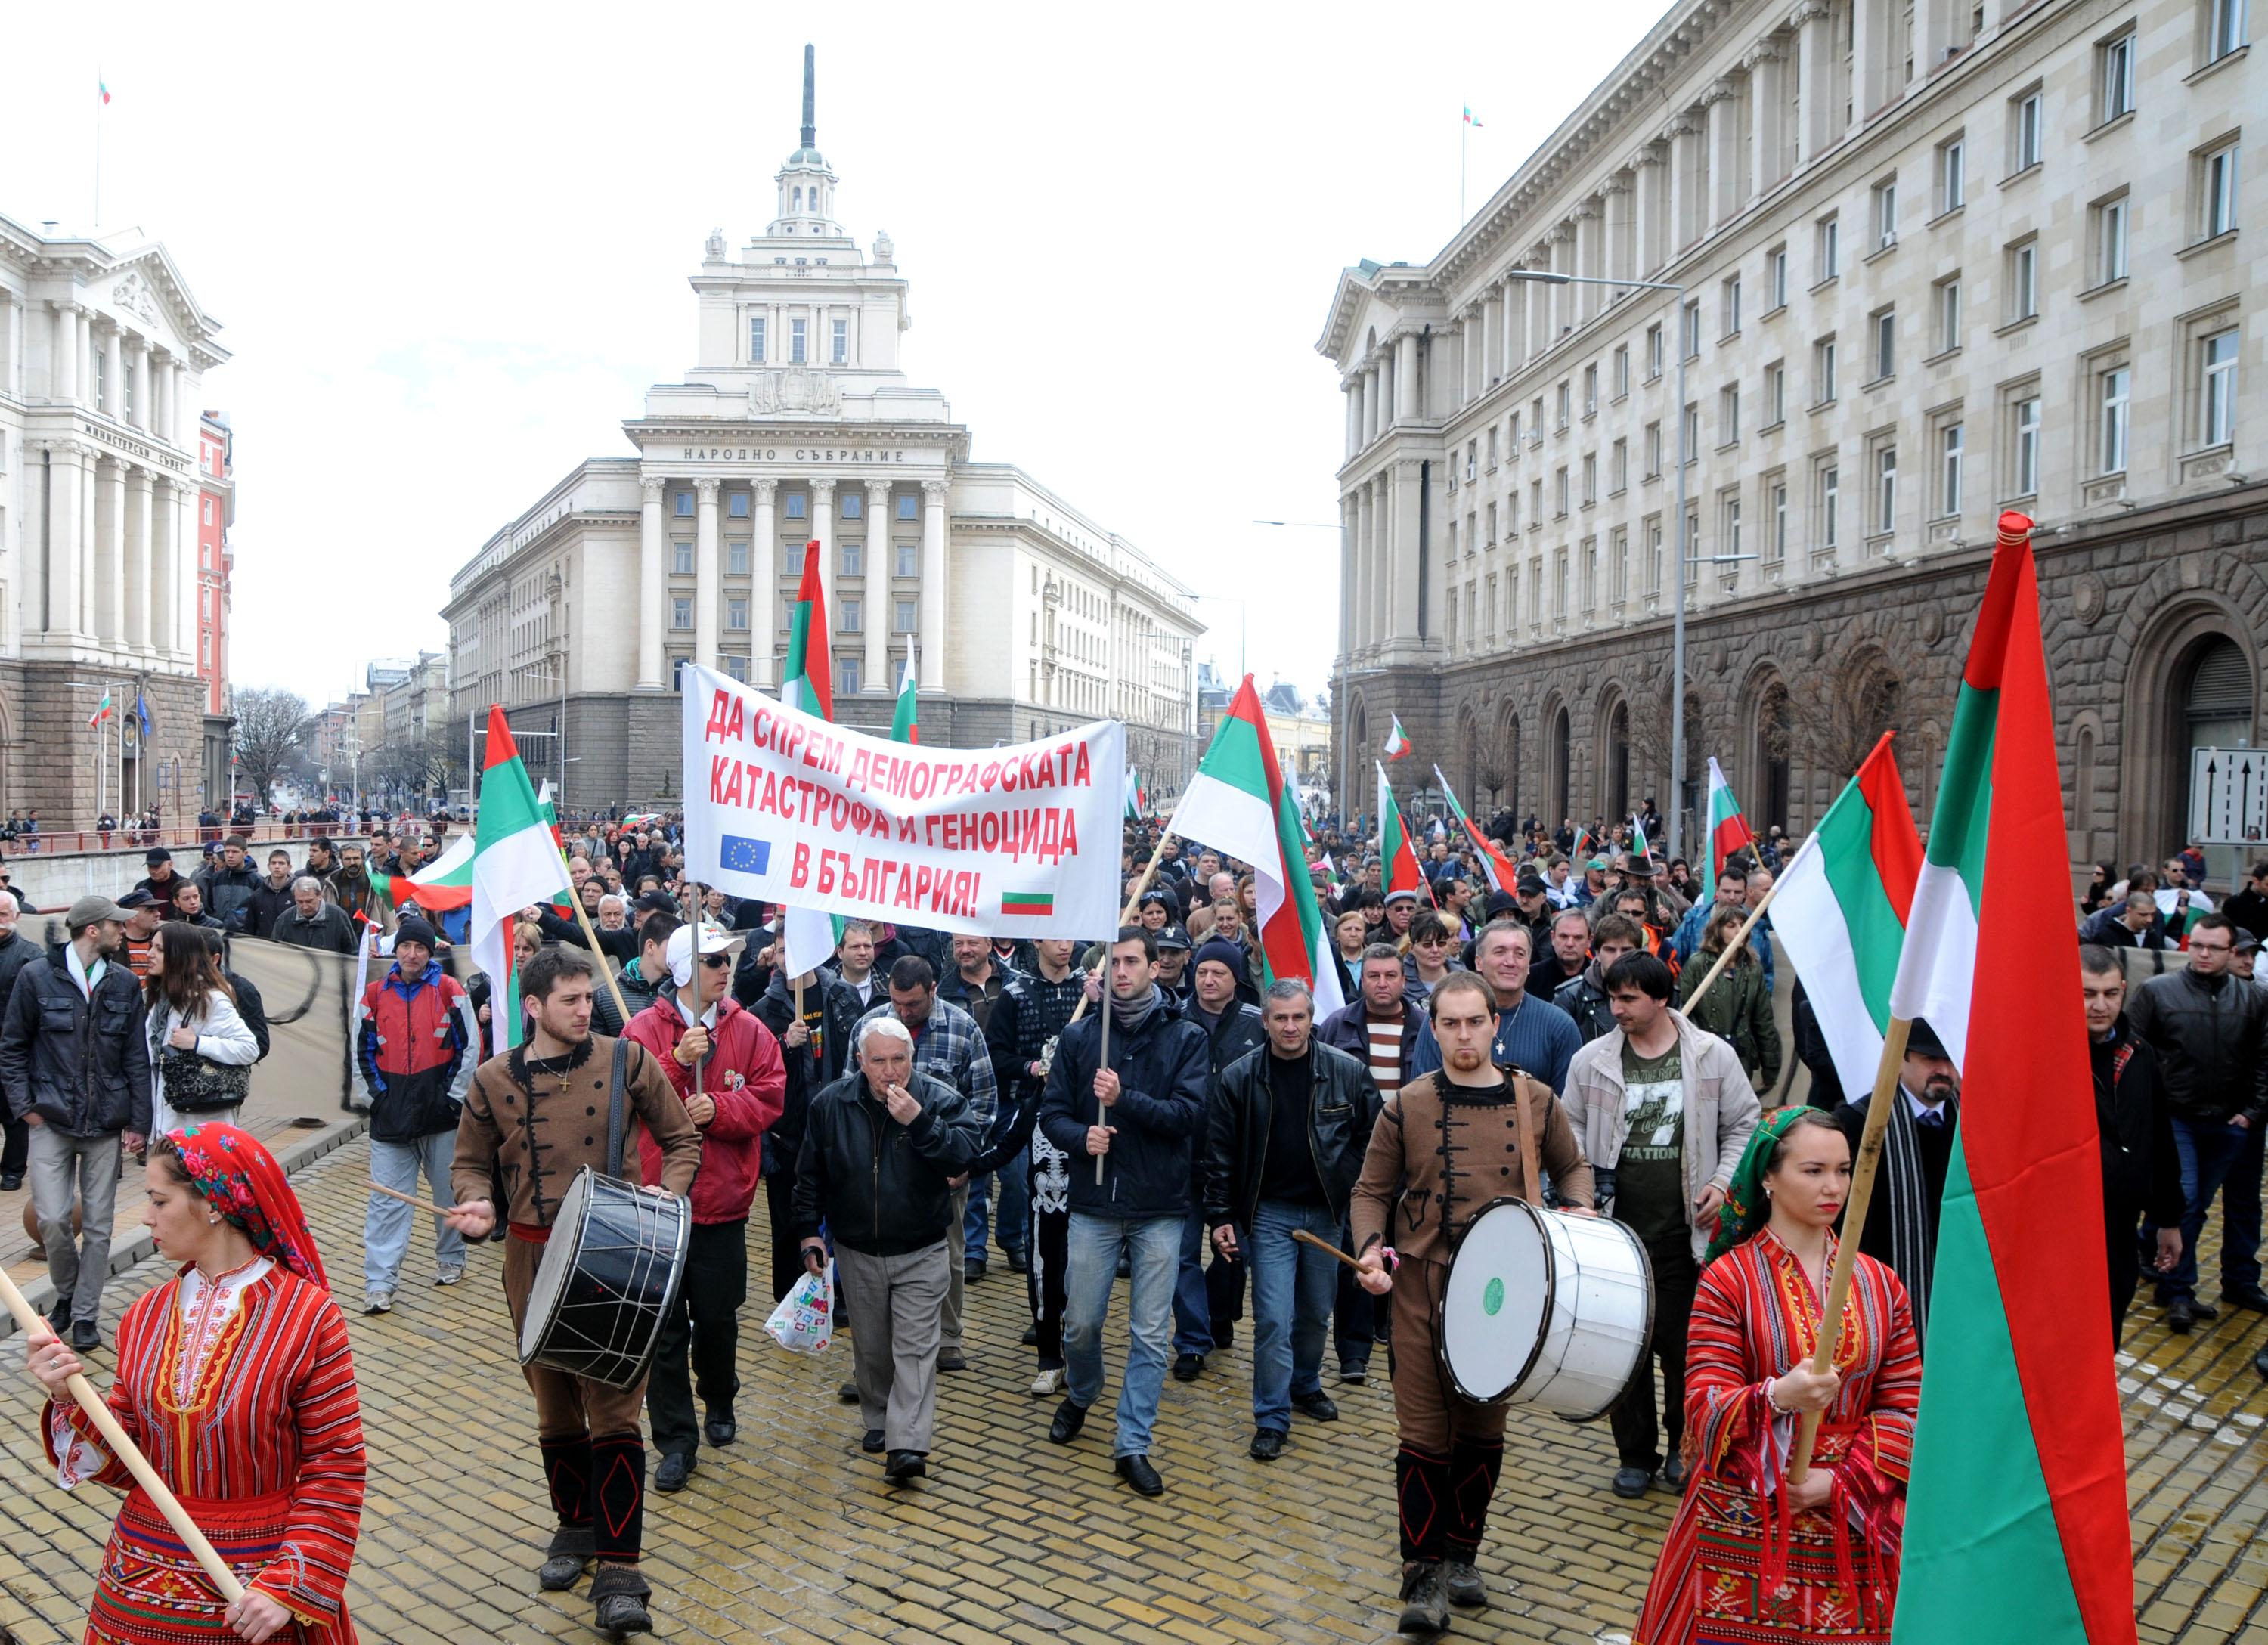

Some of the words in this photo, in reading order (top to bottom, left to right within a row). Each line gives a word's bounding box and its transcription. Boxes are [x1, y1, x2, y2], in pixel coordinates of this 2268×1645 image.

[85, 424, 150, 458] МИНИСТЕРСКИ
[159, 454, 184, 471] СЪВЕТ
[684, 448, 776, 460] НАРОДНО
[795, 449, 903, 462] СЪБРАНИЕ
[705, 689, 744, 745] ДА
[753, 707, 844, 775] СПРЕМ
[845, 741, 1092, 801] ДЕМОГРАФСКАТА
[710, 754, 890, 840] КАТАСТРОФА
[896, 815, 917, 844] И
[925, 807, 1078, 866] ГЕНОЦИДА
[789, 841, 811, 889] В
[816, 848, 981, 919] БЪЛГАРИЯ!
